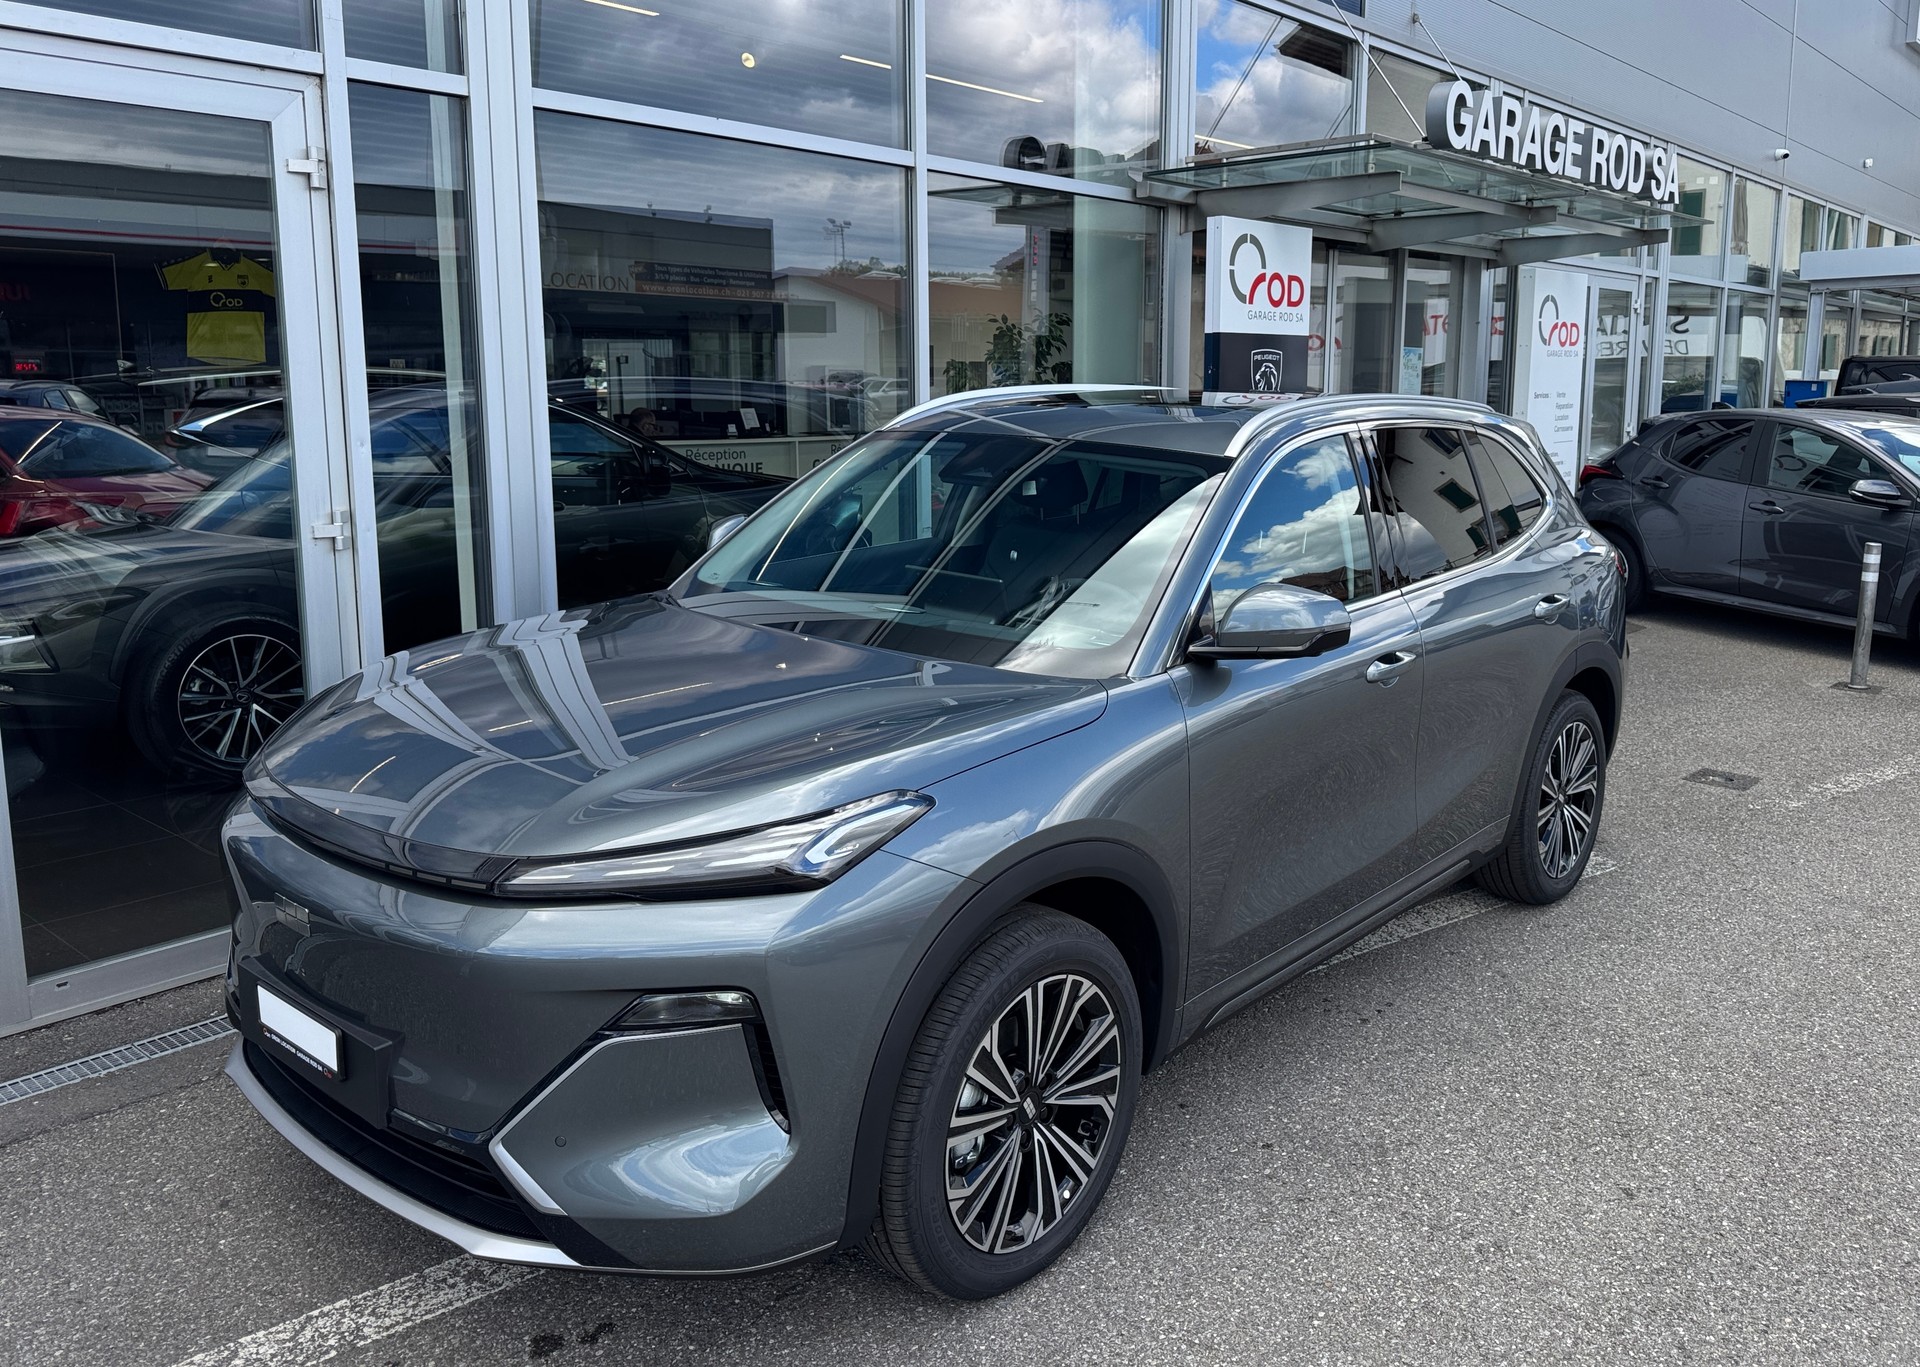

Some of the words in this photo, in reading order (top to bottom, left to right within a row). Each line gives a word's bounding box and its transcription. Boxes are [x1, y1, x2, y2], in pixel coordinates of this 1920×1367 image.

[1446, 81, 1586, 179] GARAGE
[1589, 127, 1646, 194] ROD
[1651, 147, 1680, 204] SA
[641, 283, 731, 296] www.oronlocation.ch
[1247, 310, 1277, 322] GARAGE
[1279, 312, 1294, 322] ROD
[1295, 313, 1304, 323] SA
[1254, 353, 1280, 361] PEUGEOT
[1546, 349, 1563, 358] GARAGE
[685, 448, 746, 463] Réception
